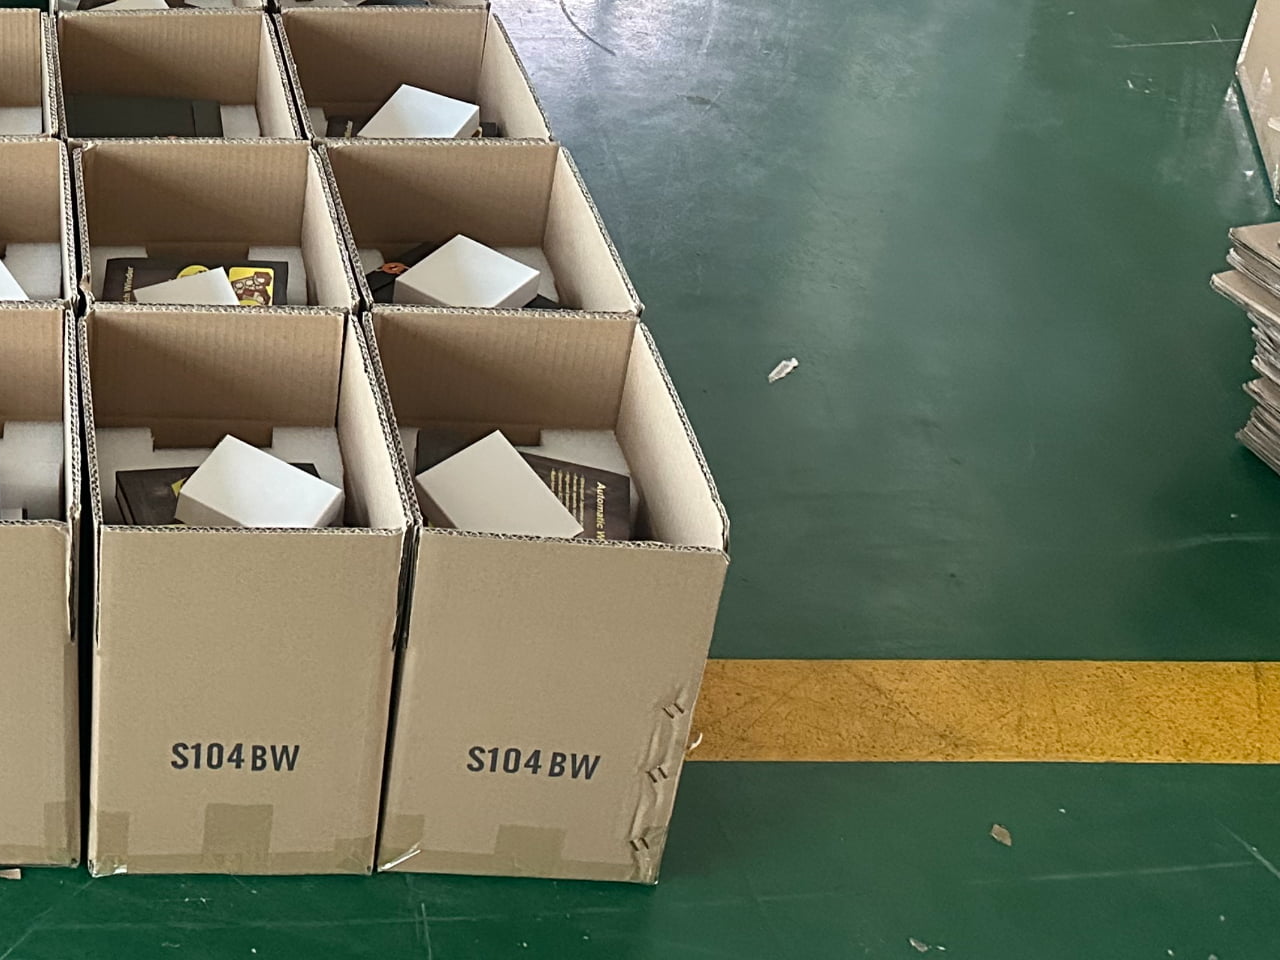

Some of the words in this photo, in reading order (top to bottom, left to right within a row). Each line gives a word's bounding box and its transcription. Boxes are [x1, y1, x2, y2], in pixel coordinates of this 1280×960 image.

[596, 481, 607, 529] Automatic
[171, 743, 299, 771] S104BW
[467, 746, 600, 779] S104BW
